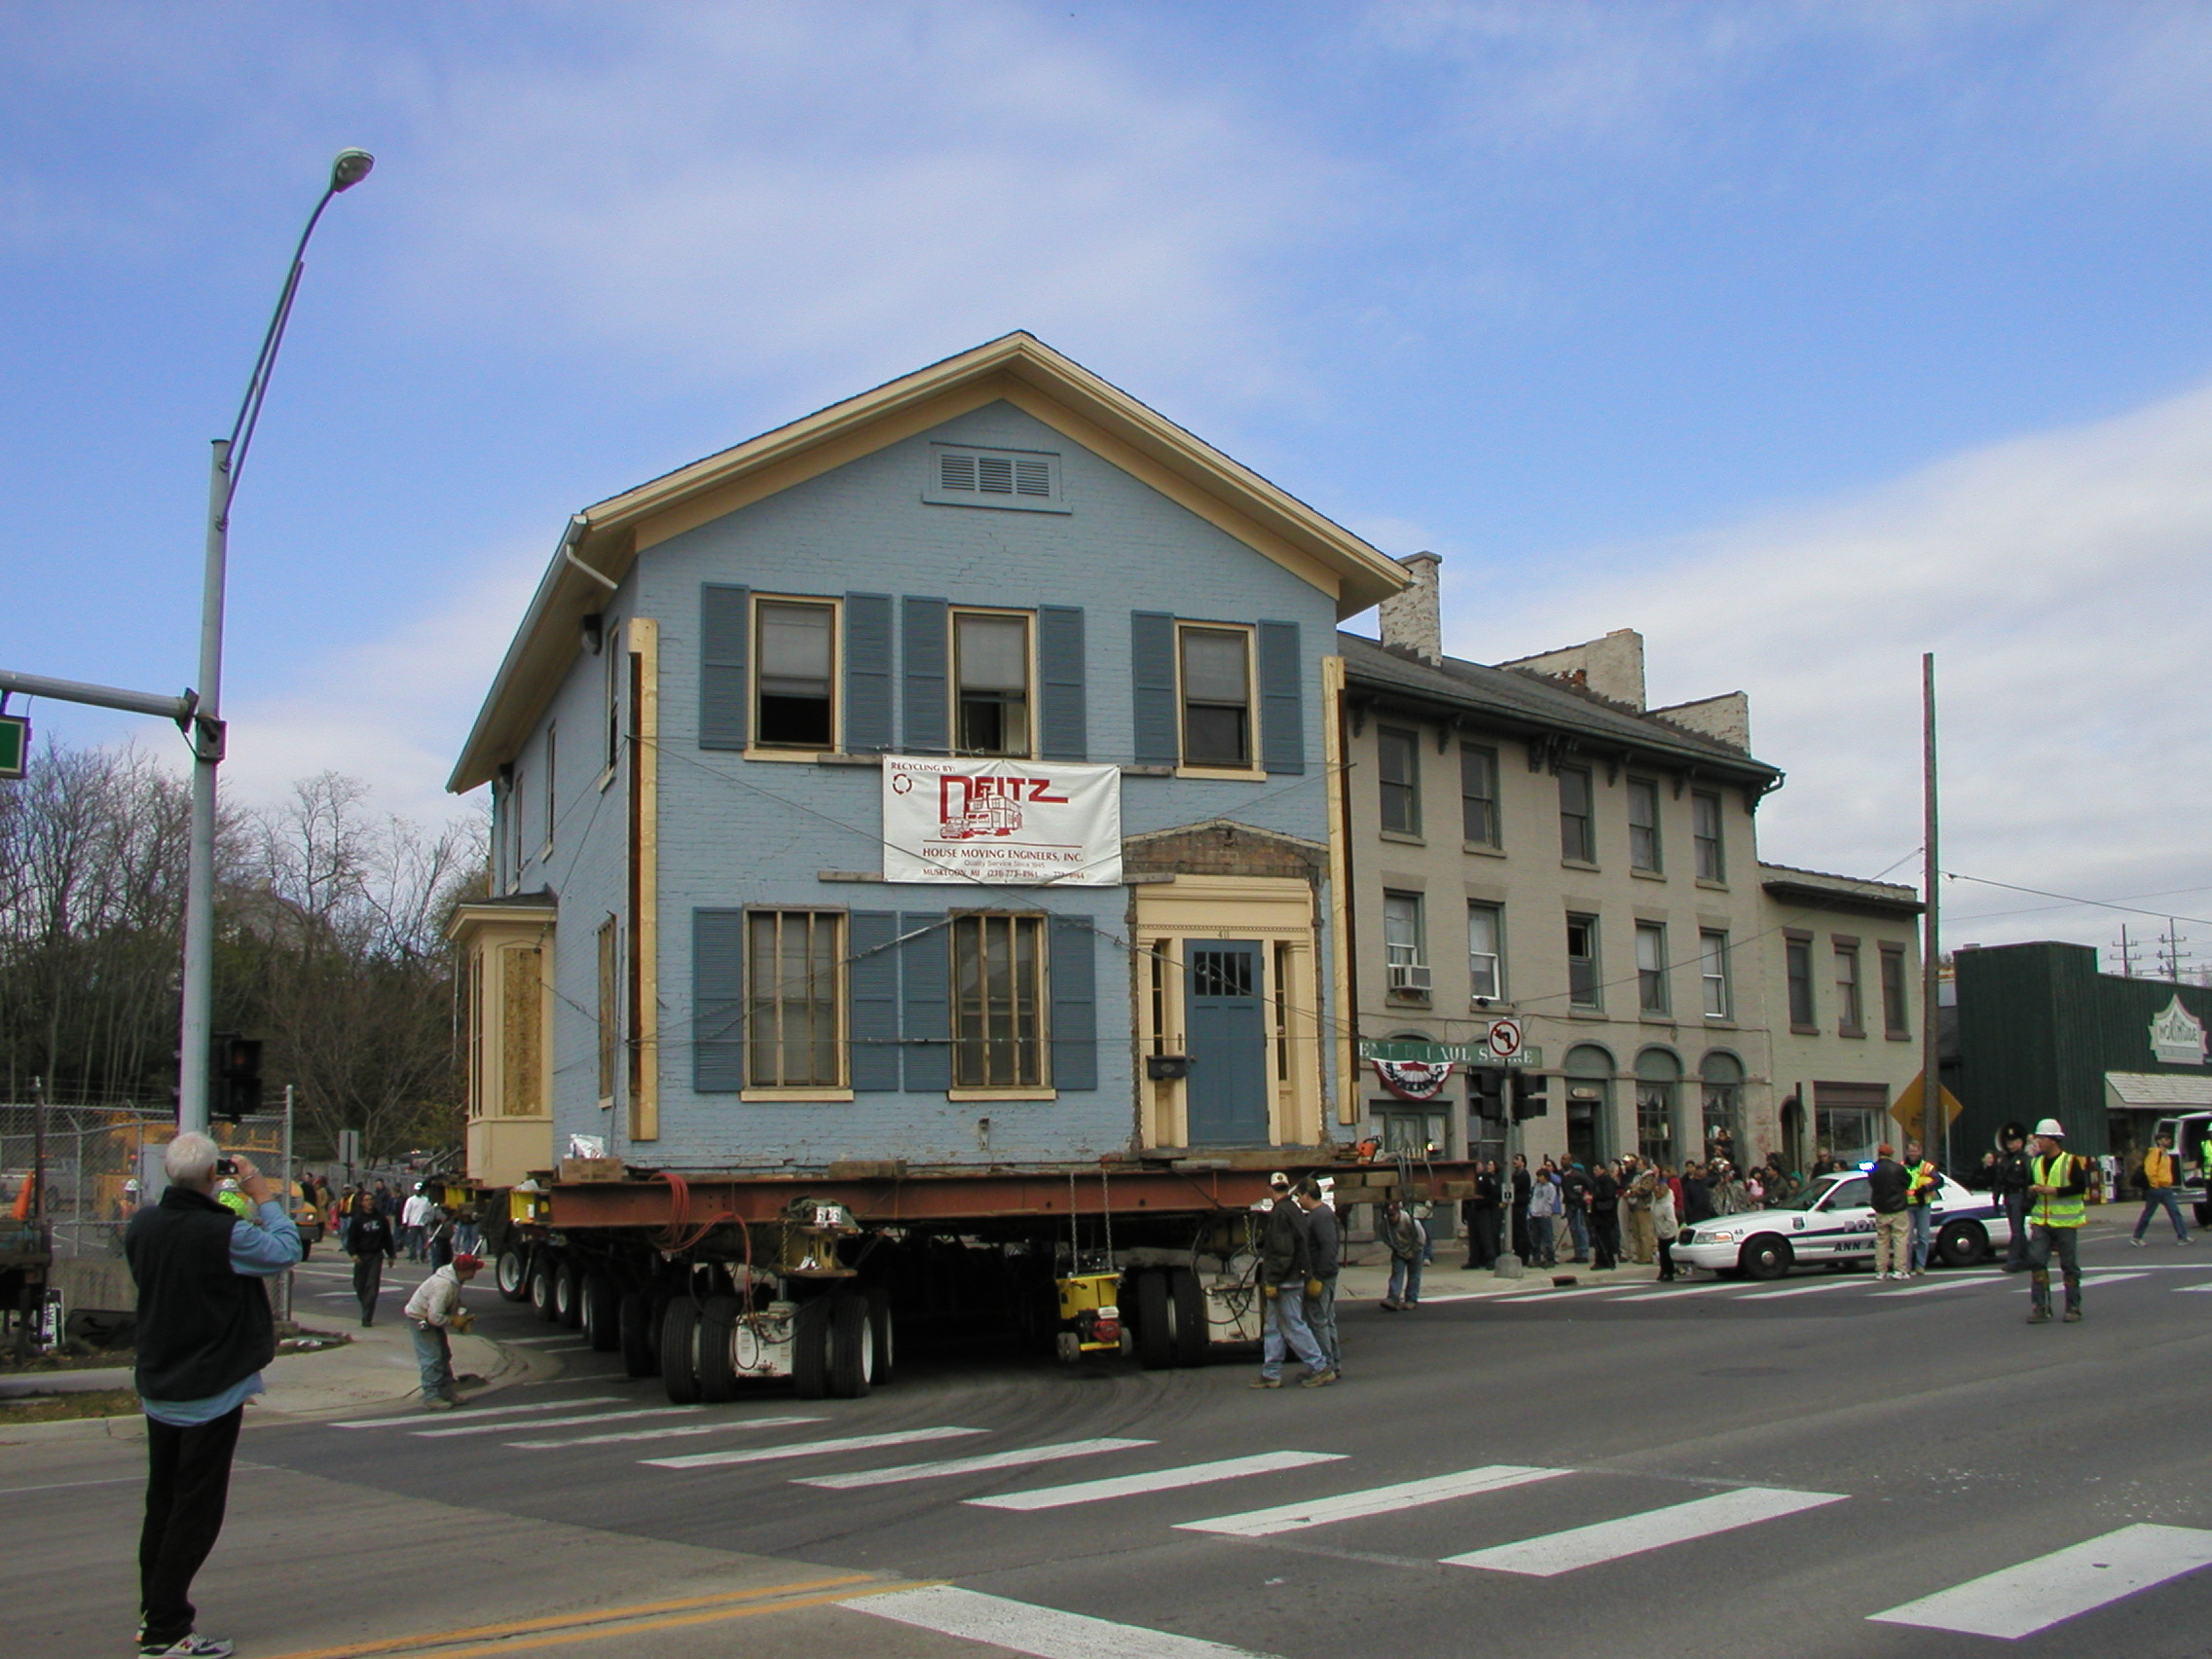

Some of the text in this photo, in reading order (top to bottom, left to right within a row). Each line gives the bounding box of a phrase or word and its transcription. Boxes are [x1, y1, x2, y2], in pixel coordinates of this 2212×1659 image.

[891, 762, 940, 772] RECYCLING
[940, 775, 1069, 824] DEITZ
[922, 847, 1084, 862] HOUSE MOVING ENGINEERS, INC.
[1833, 1239, 1861, 1252] ANN
